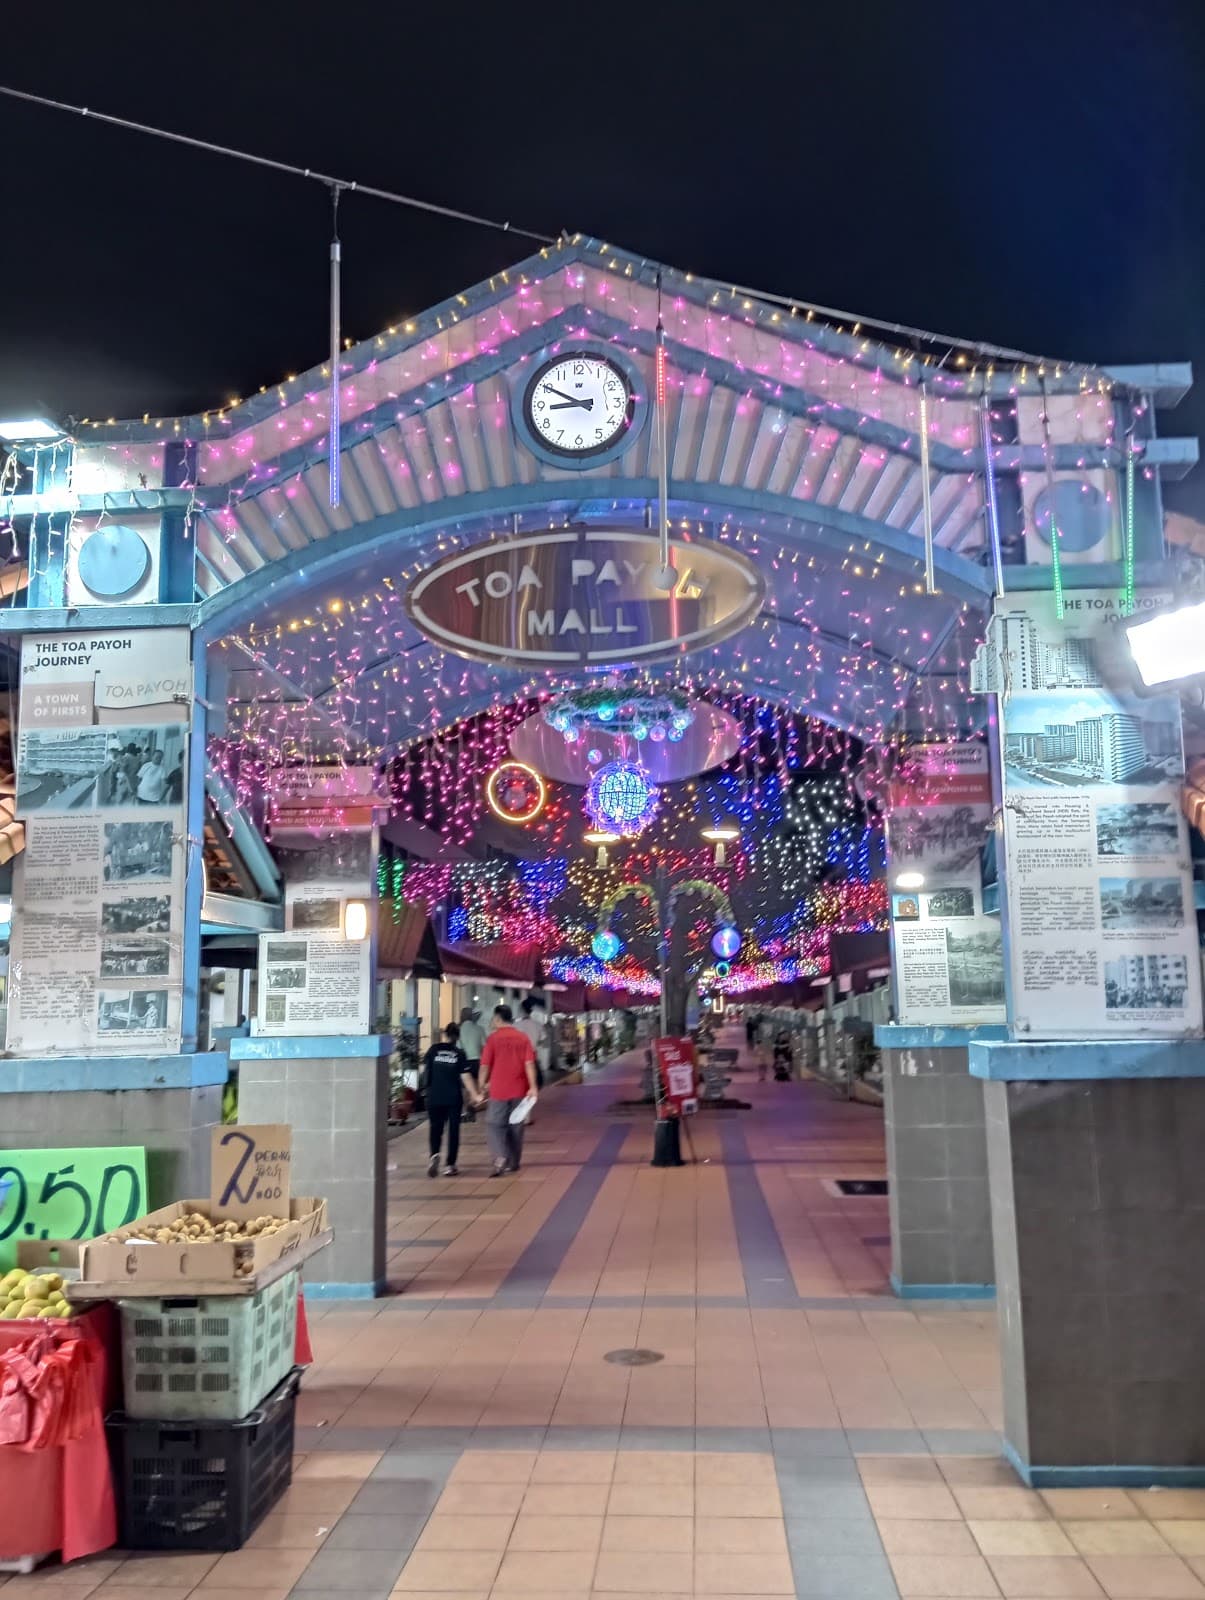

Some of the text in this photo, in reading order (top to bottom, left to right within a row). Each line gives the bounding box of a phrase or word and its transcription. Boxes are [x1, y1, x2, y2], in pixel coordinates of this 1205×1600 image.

[557, 370, 566, 381] 11
[573, 364, 585, 375] 12
[607, 380, 617, 392] 2
[536, 401, 546, 412] 9
[613, 398, 622, 409] 3
[542, 418, 551, 429] 8
[606, 415, 616, 426] 4
[557, 429, 565, 441] 7
[574, 434, 584, 446] 6
[595, 428, 603, 440] 5
[456, 559, 710, 607] TOA PAYH
[1062, 600, 1082, 610] HE
[1086, 599, 1114, 609] TOA
[527, 607, 638, 636] MALL
[35, 639, 132, 653] THE TOA PAYOH
[34, 655, 92, 667] JOURNEY
[104, 679, 188, 698] TOA PAYOH
[34, 693, 80, 705] A TOWN
[33, 706, 88, 717] OF FIRSTS
